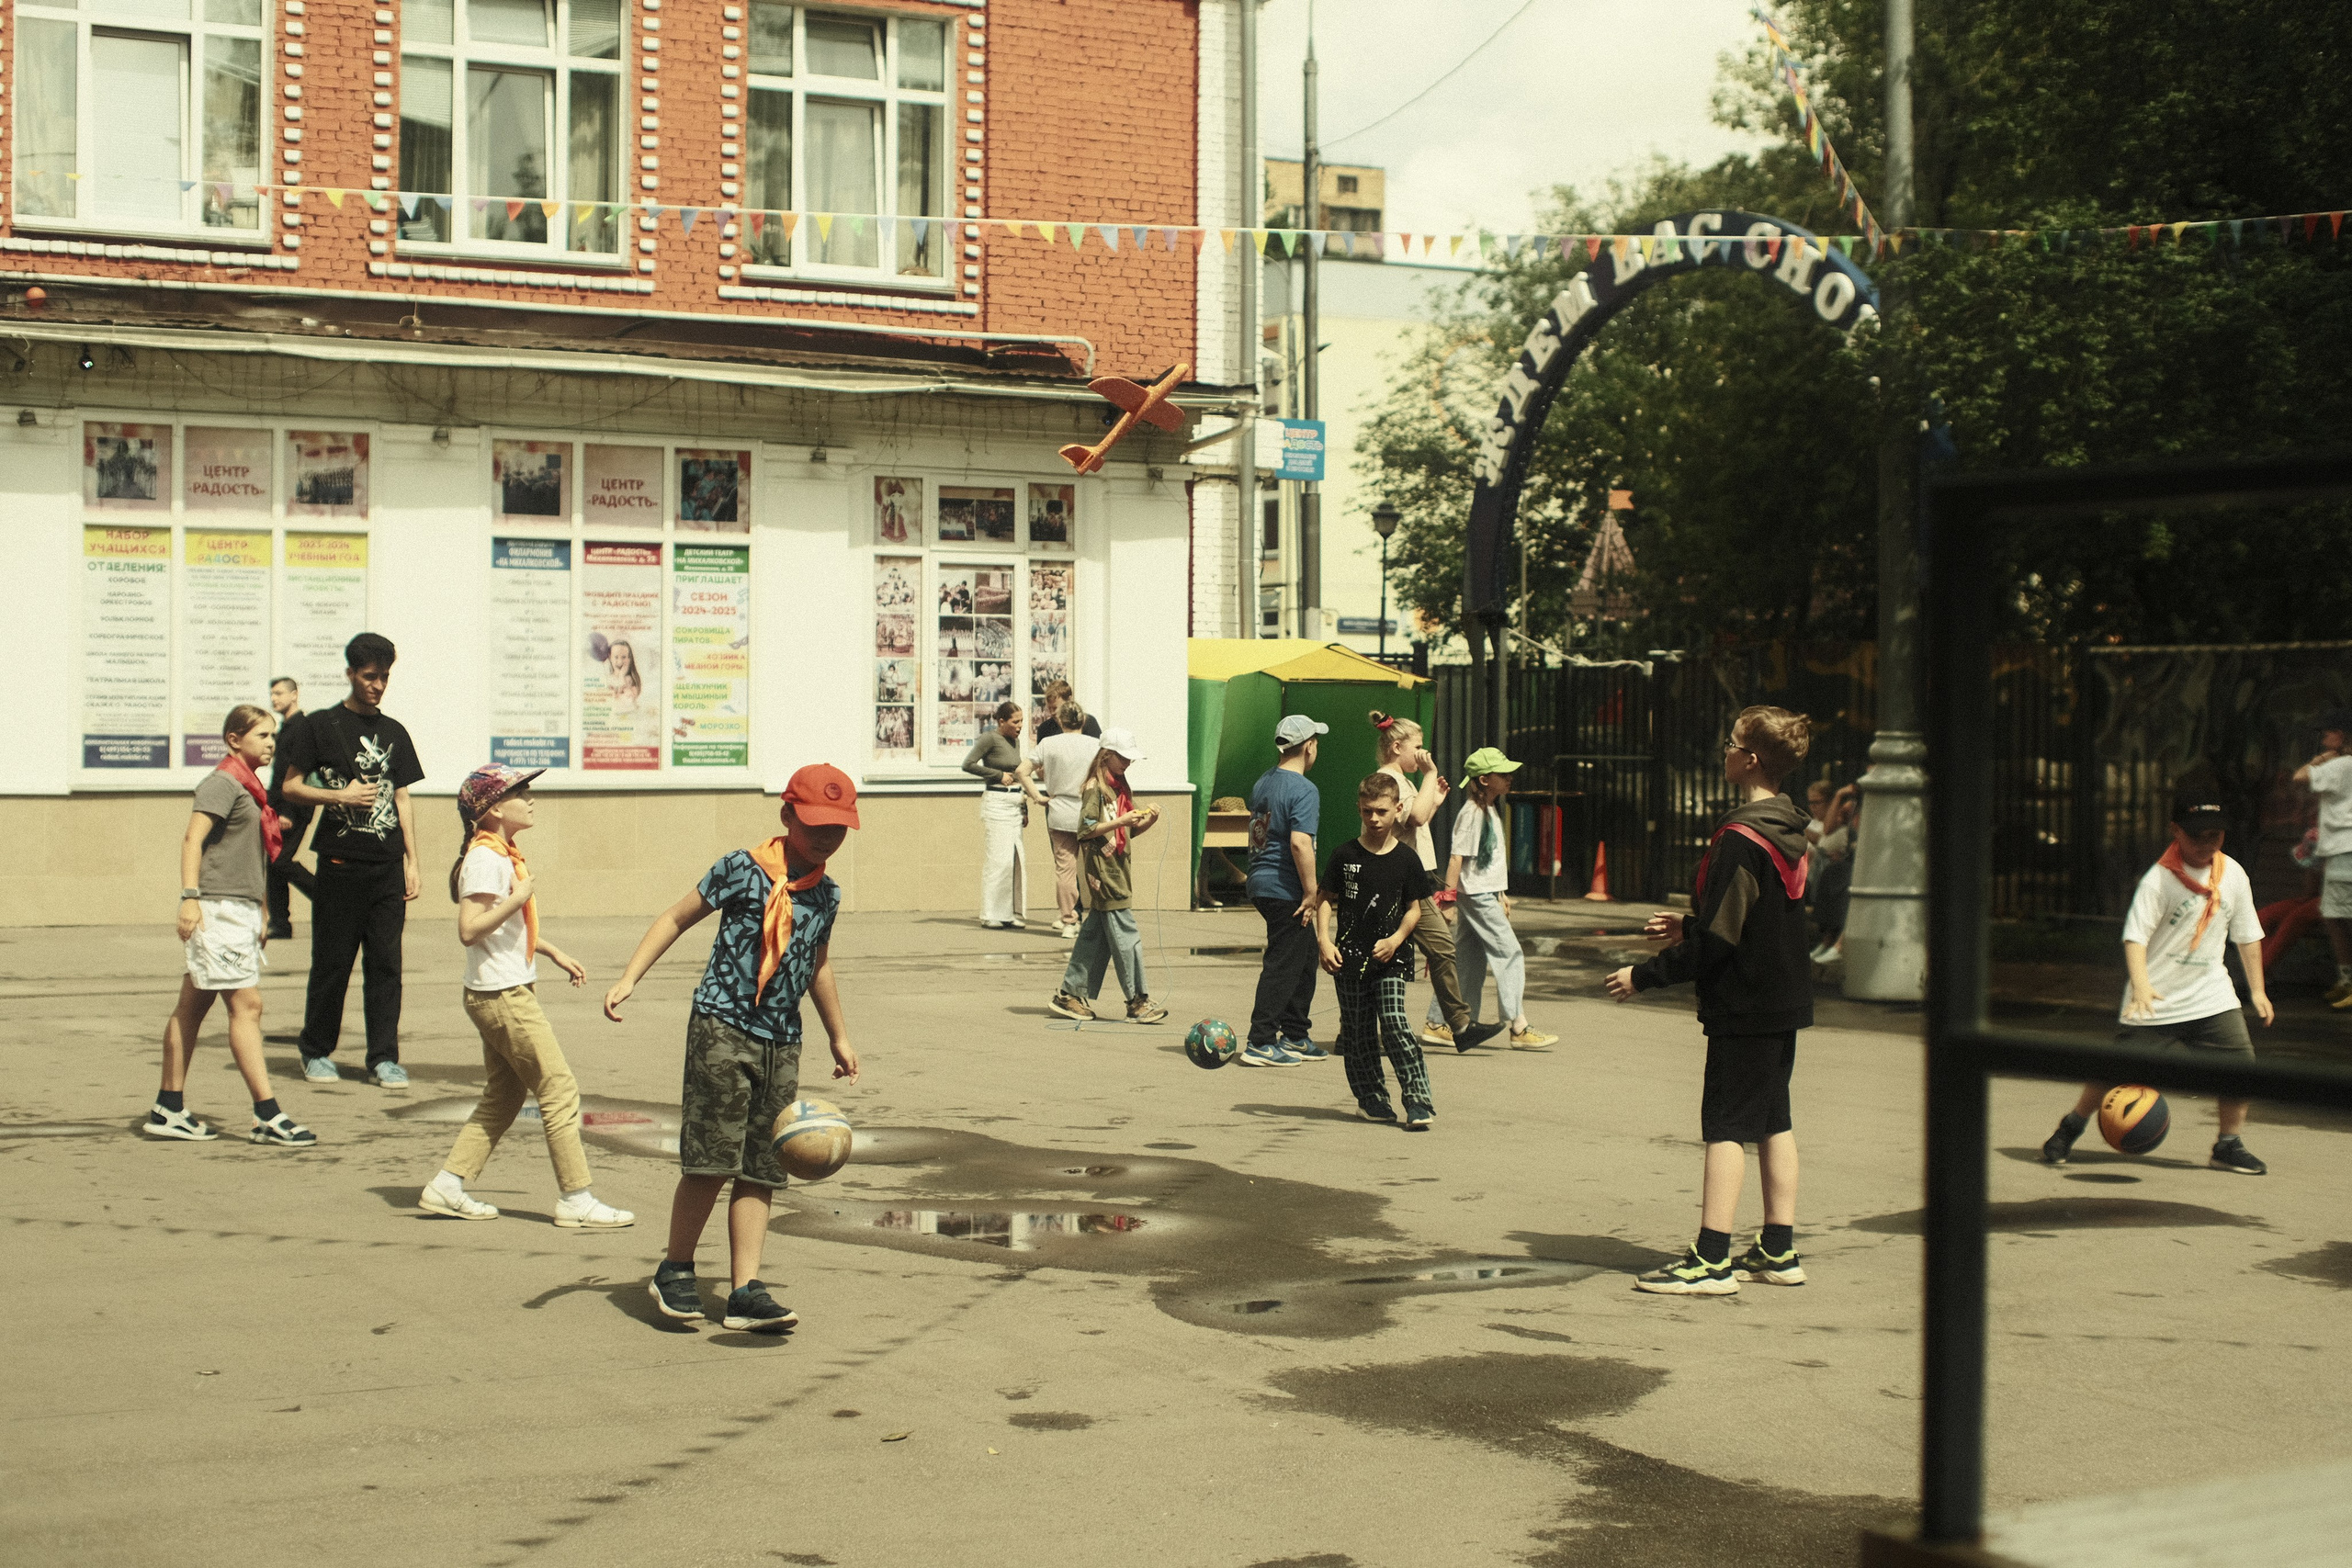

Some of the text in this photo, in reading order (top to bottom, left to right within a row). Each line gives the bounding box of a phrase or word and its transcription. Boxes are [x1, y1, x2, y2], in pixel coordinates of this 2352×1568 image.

[1610, 213, 1724, 287] ВАС
[203, 465, 250, 479] ЦЕНТР
[601, 479, 644, 491] ЦЕНТР
[106, 530, 149, 540] НАБОР
[89, 543, 166, 554] УЧАЩИХСЯ
[207, 539, 249, 550] ЦЕНТР
[288, 551, 360, 561] УЧЕБНЫЙ ГОД
[675, 575, 742, 584] ПРИГЛАШАЕТ
[690, 592, 728, 601] СЕЗОН
[682, 605, 737, 615] 2024-2025
[1343, 863, 1362, 873] JUST
[1343, 880, 1359, 891] YOUR
